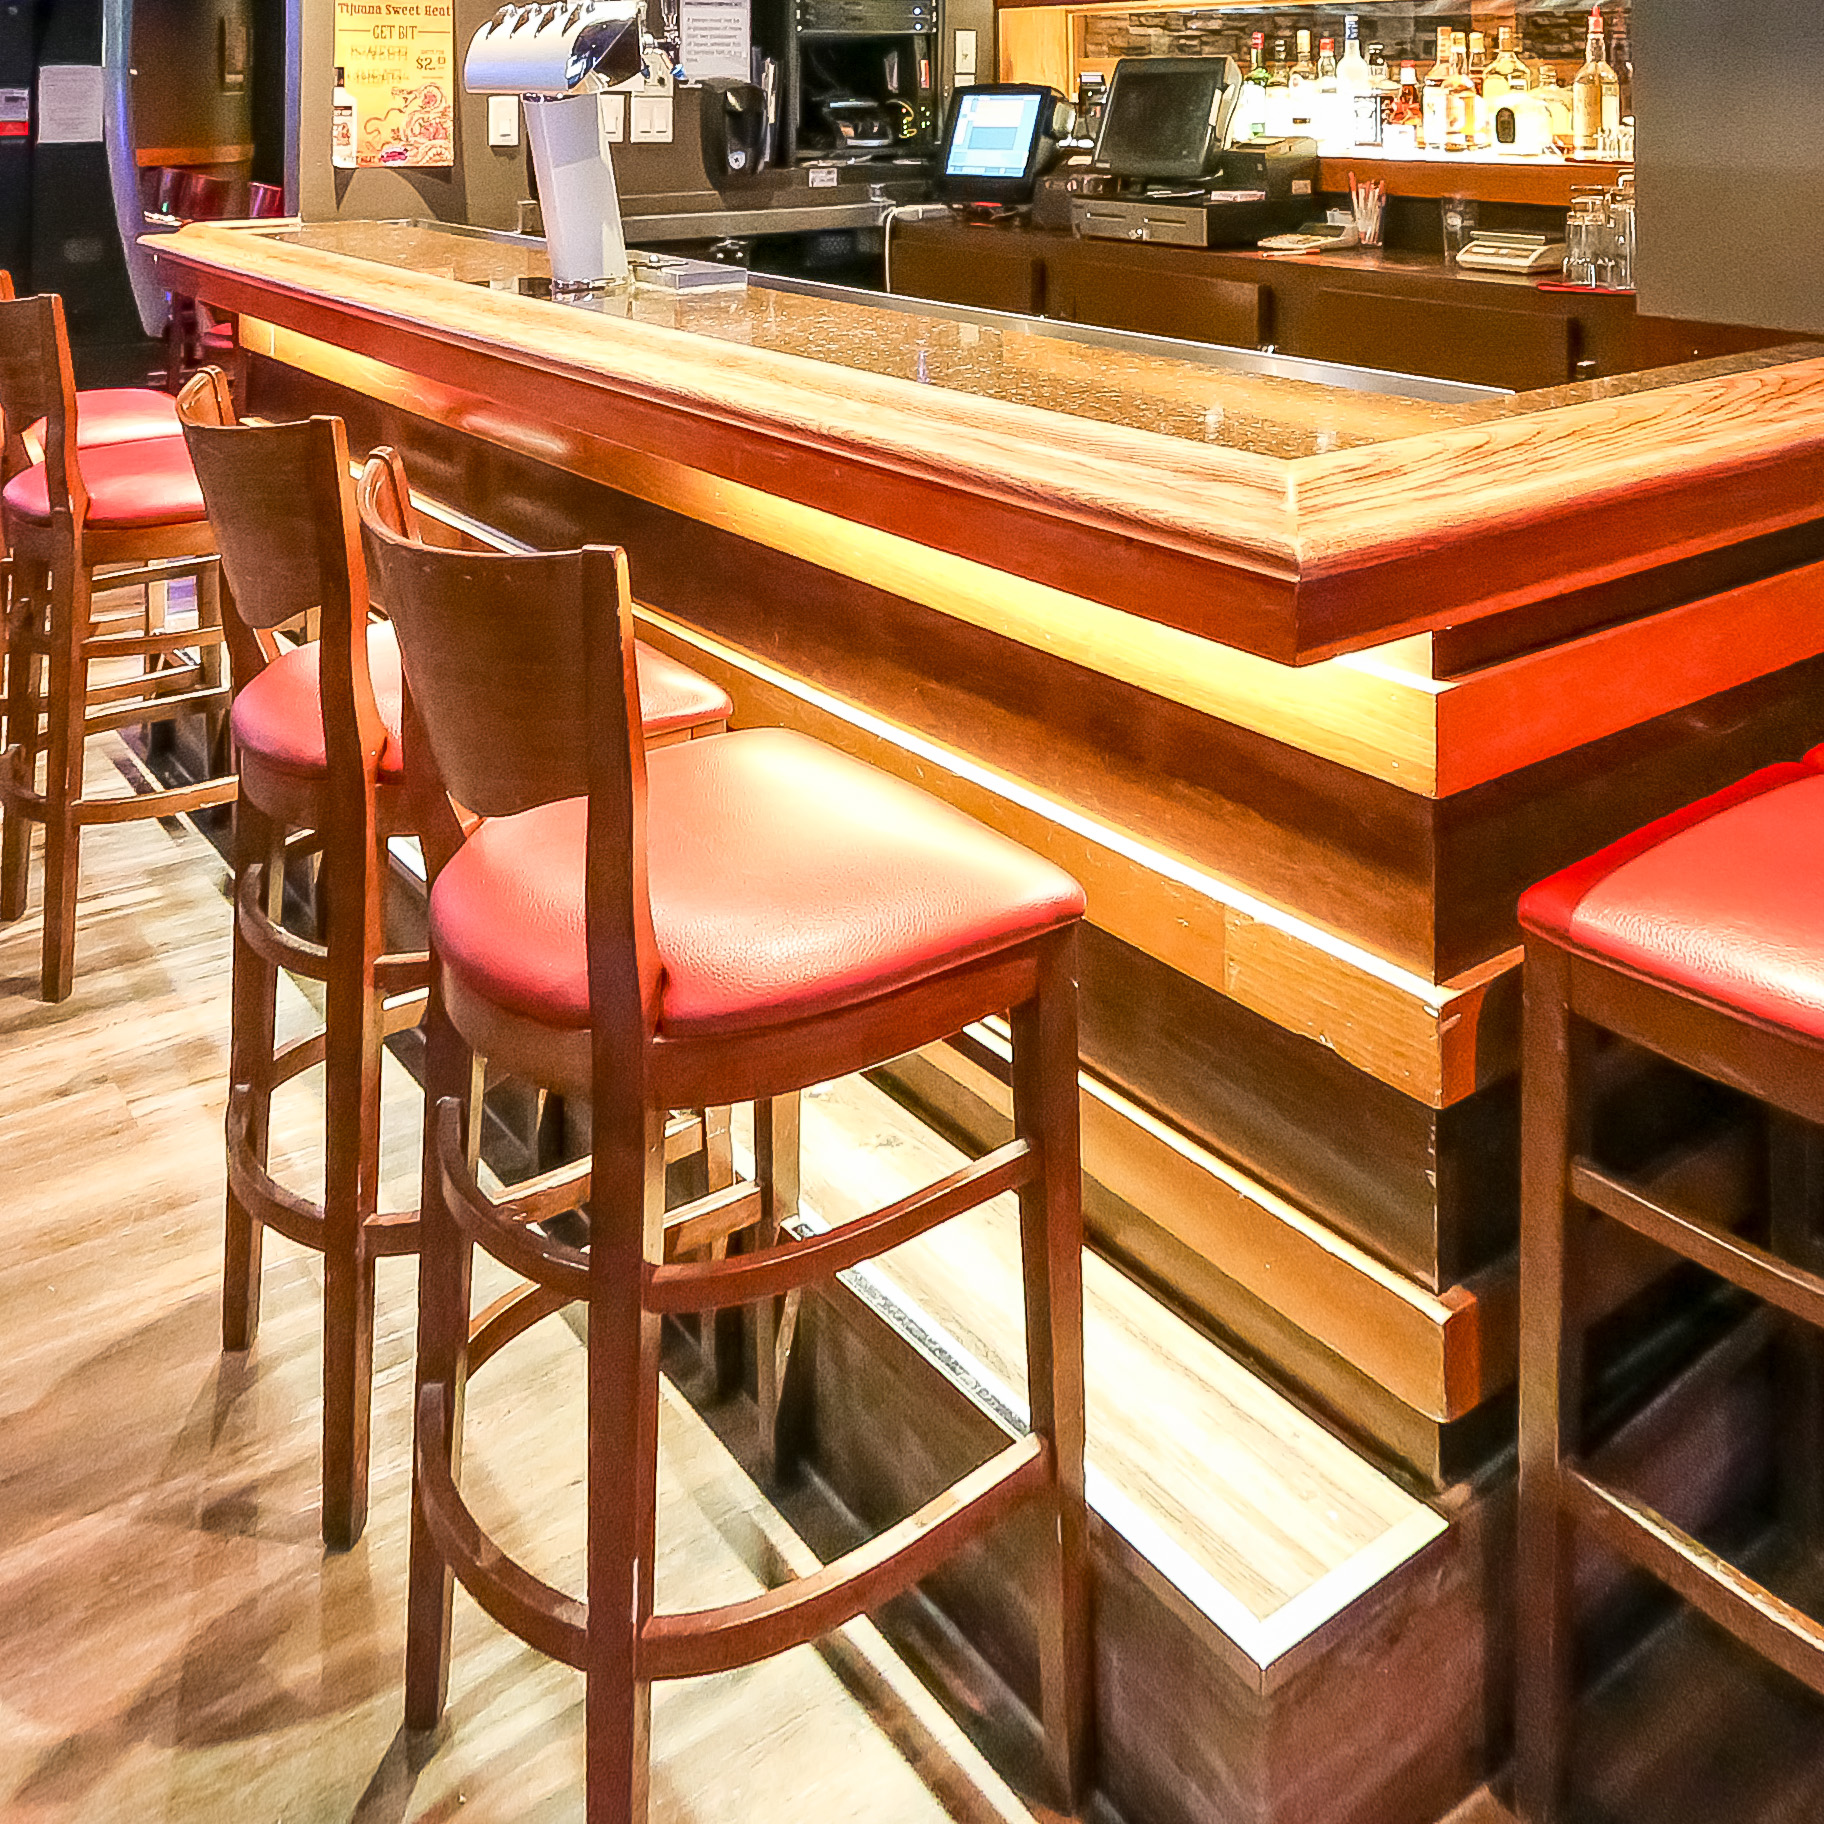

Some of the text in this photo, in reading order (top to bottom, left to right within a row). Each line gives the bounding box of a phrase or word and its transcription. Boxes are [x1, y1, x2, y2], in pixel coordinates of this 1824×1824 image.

[337, 2, 451, 16] Tijuana Sweet Heat
[372, 24, 418, 40] GET BIT
